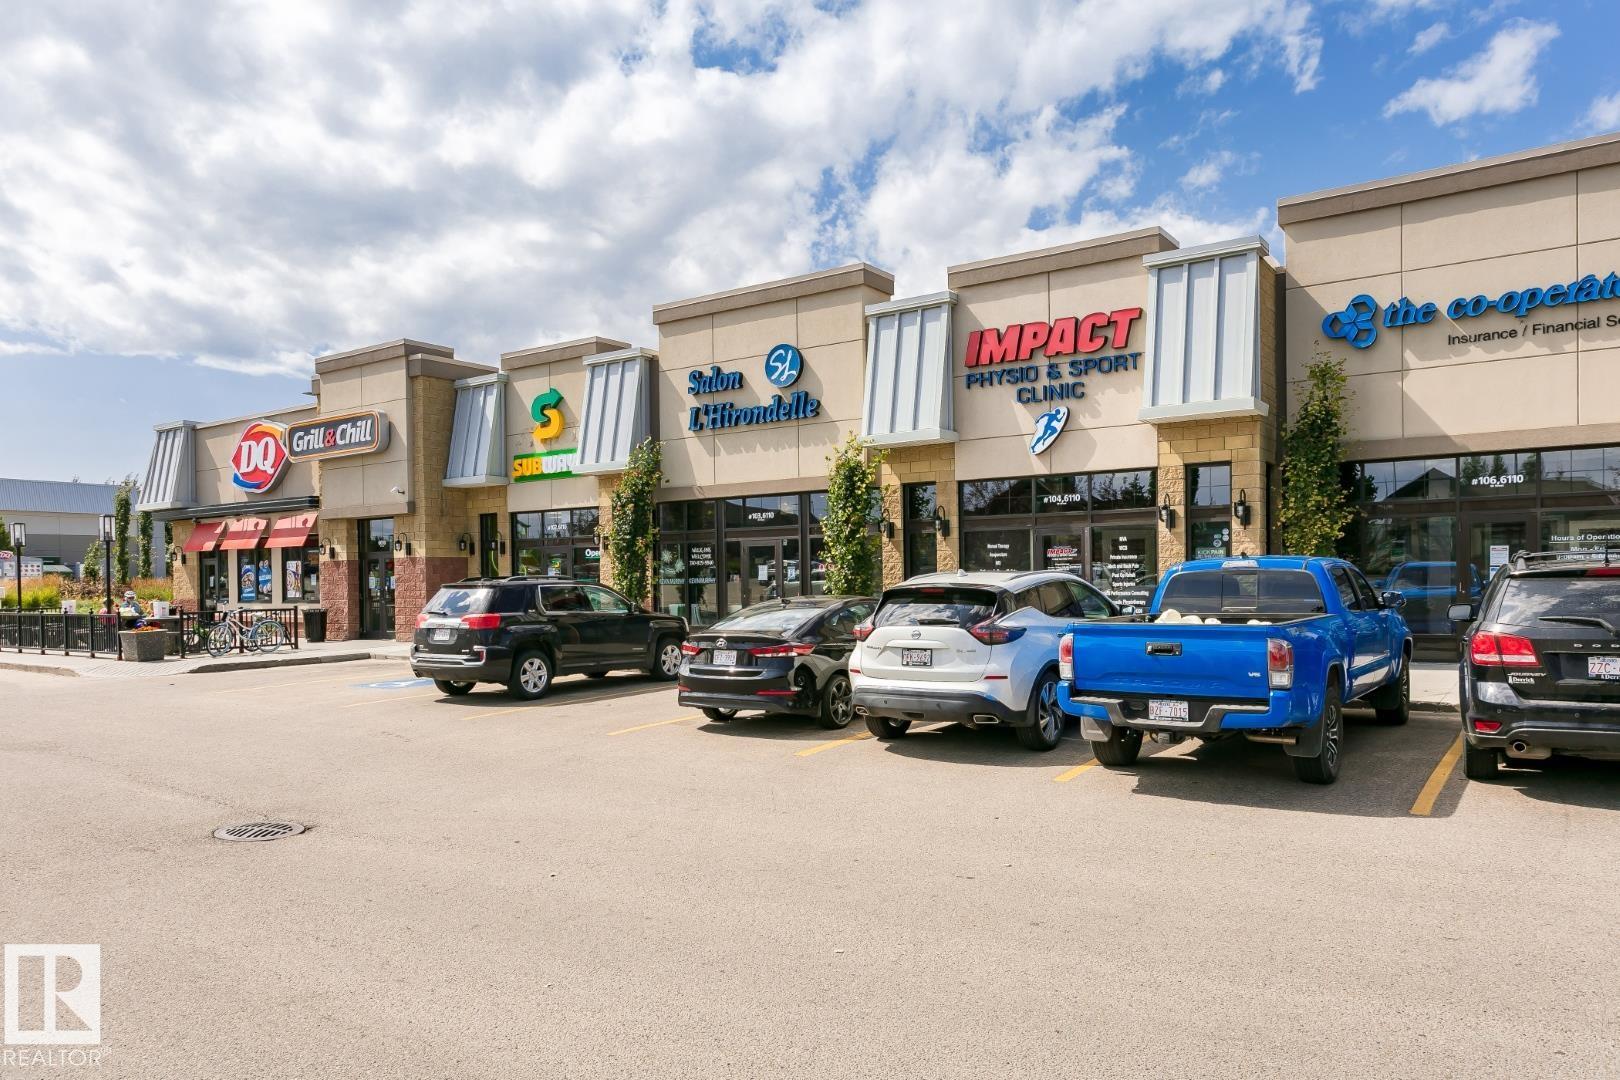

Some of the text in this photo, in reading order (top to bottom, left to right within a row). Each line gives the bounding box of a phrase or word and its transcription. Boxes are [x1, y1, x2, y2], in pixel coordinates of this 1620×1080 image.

[1383, 297, 1438, 328] the
[965, 307, 1142, 368] IMPACT
[1448, 329, 1517, 346] Insurance
[1532, 317, 1600, 336] Financial
[1606, 314, 1620, 328] S
[688, 366, 743, 395] Salon
[965, 352, 1142, 390] PHYSIO & SPORT
[1016, 381, 1085, 404] CLINIC
[688, 390, 821, 432] L'Hirondelle
[239, 436, 275, 474] DQ
[1471, 474, 1524, 486] #106,6110
[1043, 493, 1081, 504] #104,6110
[1589, 662, 1620, 674] ZZC-
